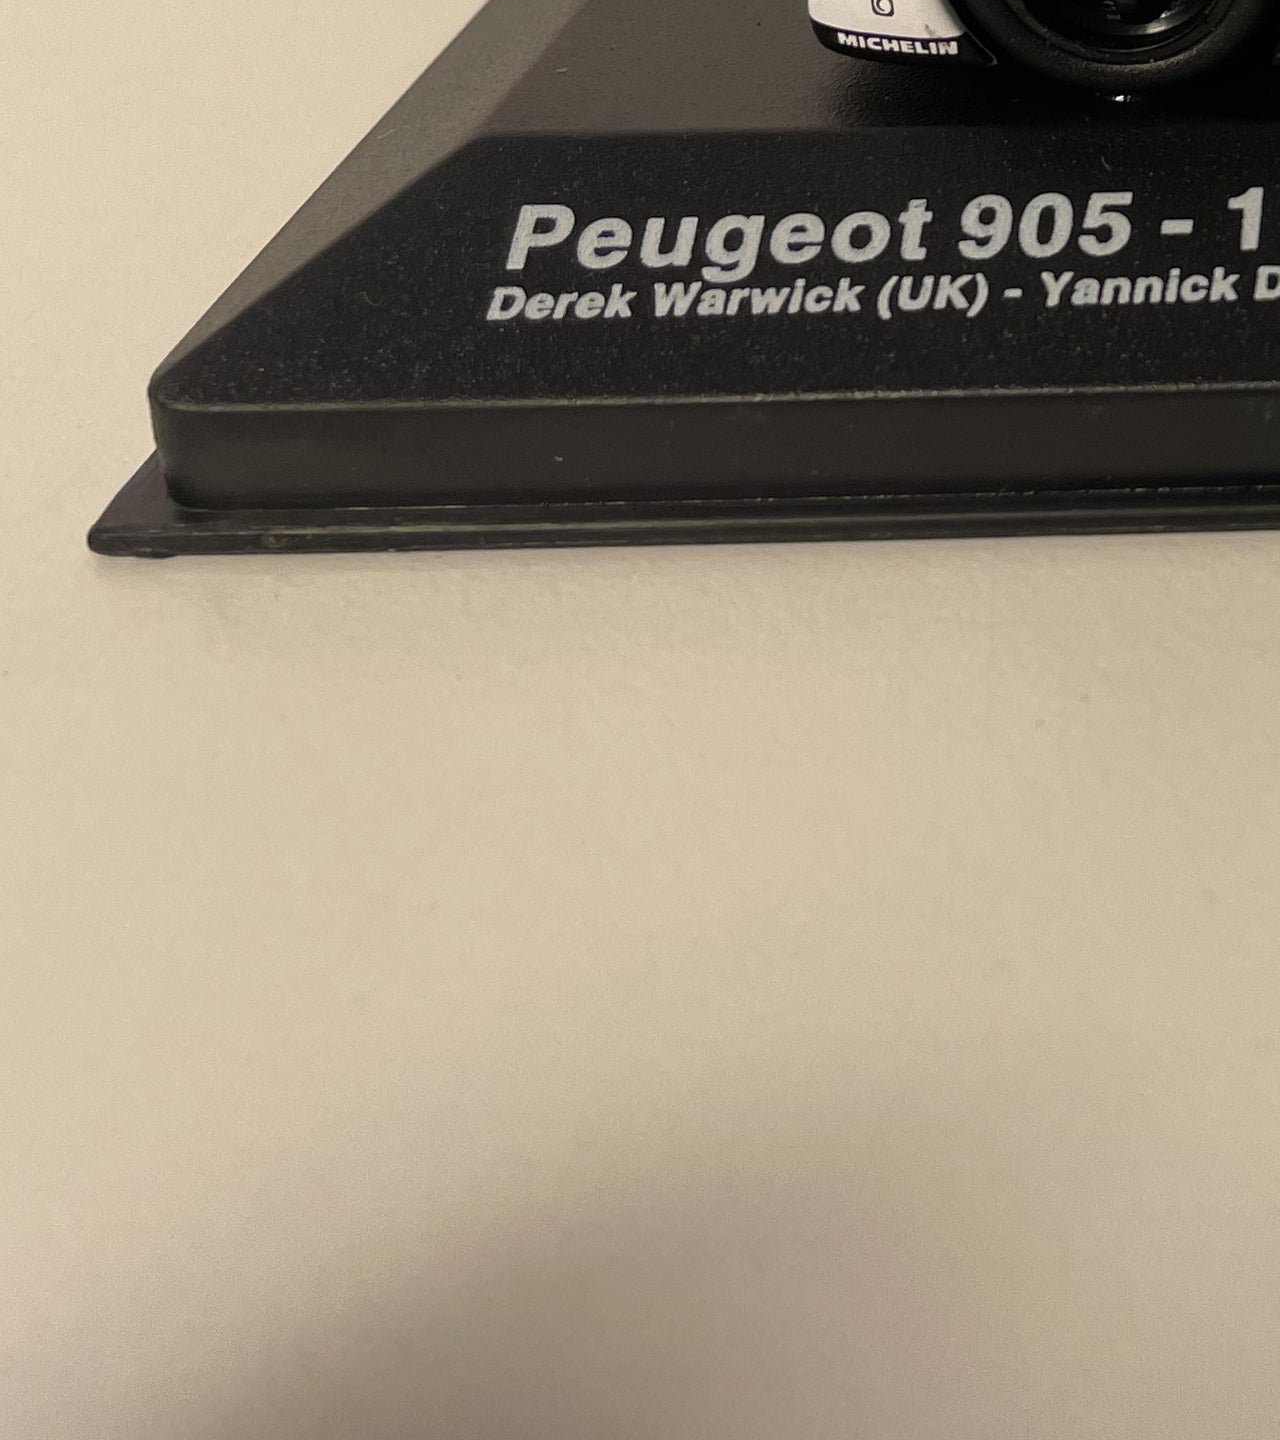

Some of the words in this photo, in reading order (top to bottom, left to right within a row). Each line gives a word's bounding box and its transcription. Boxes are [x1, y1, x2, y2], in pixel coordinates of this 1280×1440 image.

[836, 31, 959, 56] MICHELIN
[505, 198, 934, 284] Peugeot
[958, 191, 1133, 260] 905
[1160, 219, 1194, 235] -
[486, 283, 638, 321] Derek
[653, 277, 866, 318] Warwick
[876, 272, 989, 321] (UK)
[1003, 288, 1023, 298] -
[1040, 267, 1240, 307] Yannick
